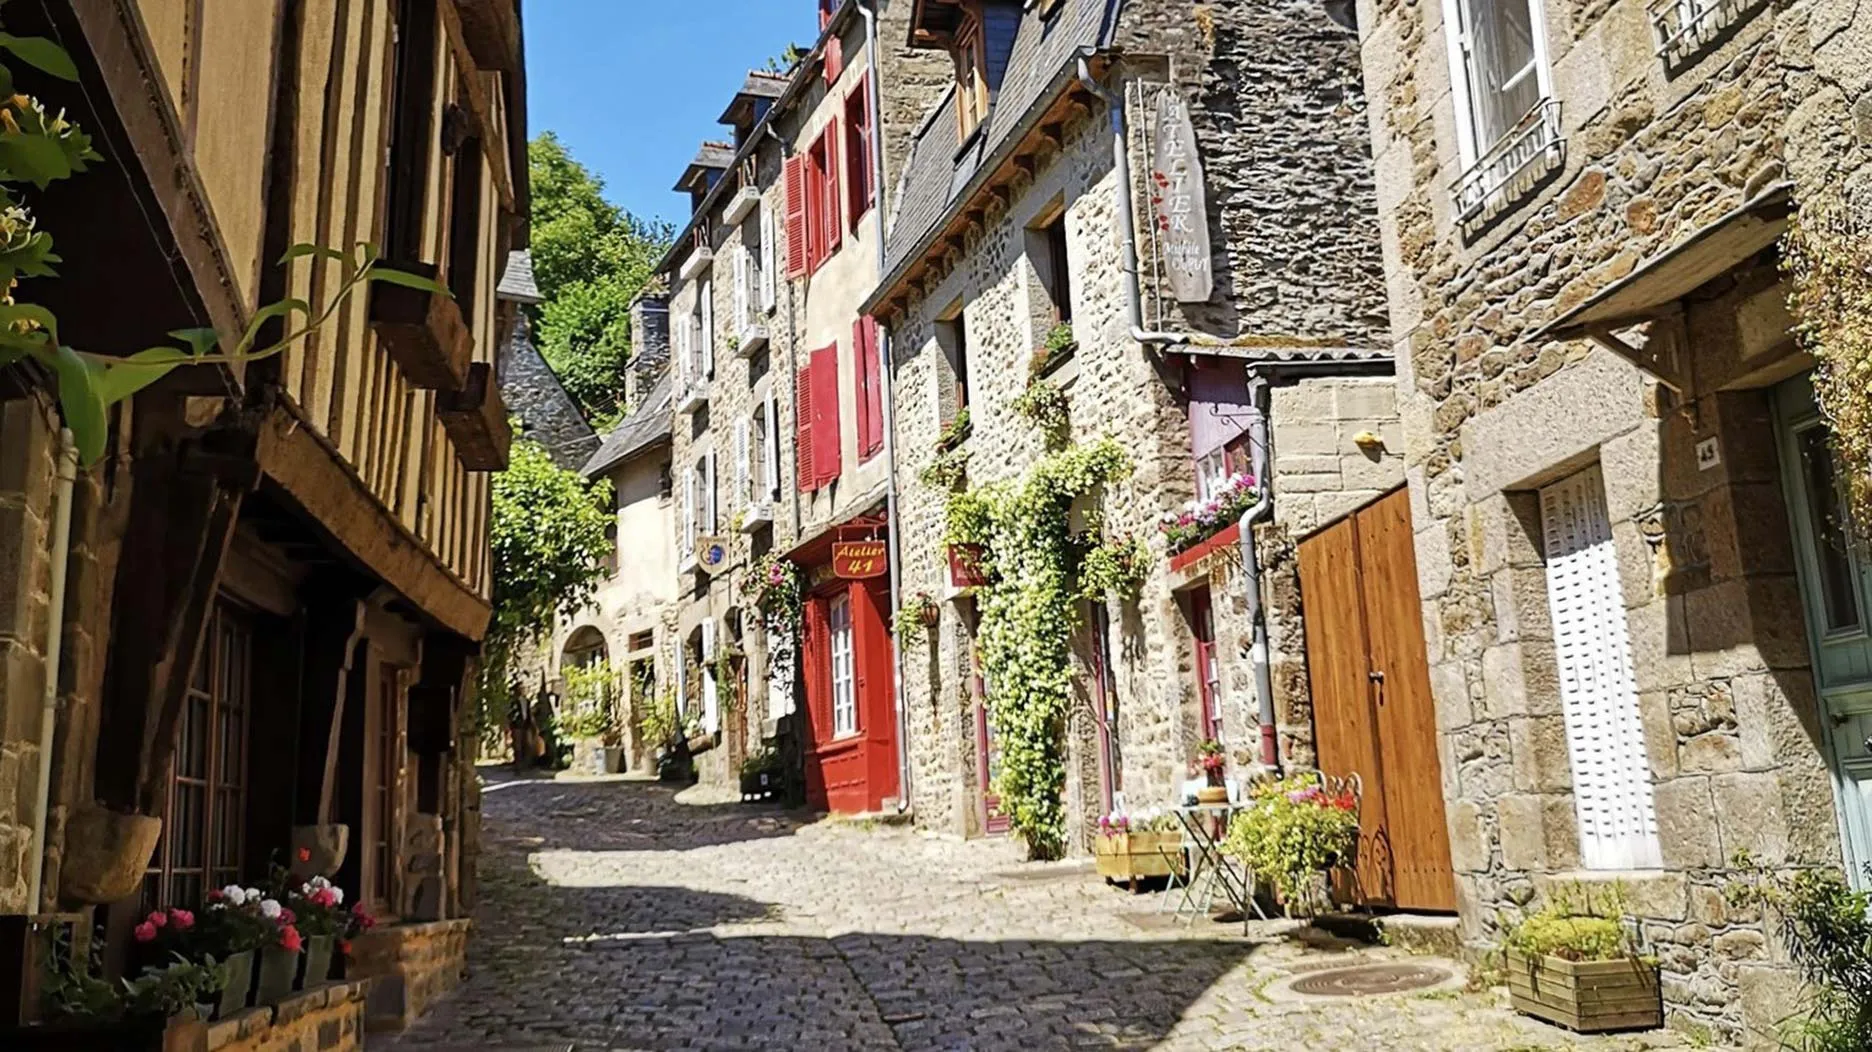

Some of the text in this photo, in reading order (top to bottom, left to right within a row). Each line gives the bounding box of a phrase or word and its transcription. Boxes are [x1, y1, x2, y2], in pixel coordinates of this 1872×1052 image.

[1162, 104, 1193, 233] ATELIER
[835, 545, 885, 561] Atelier
[848, 559, 873, 574] 41
